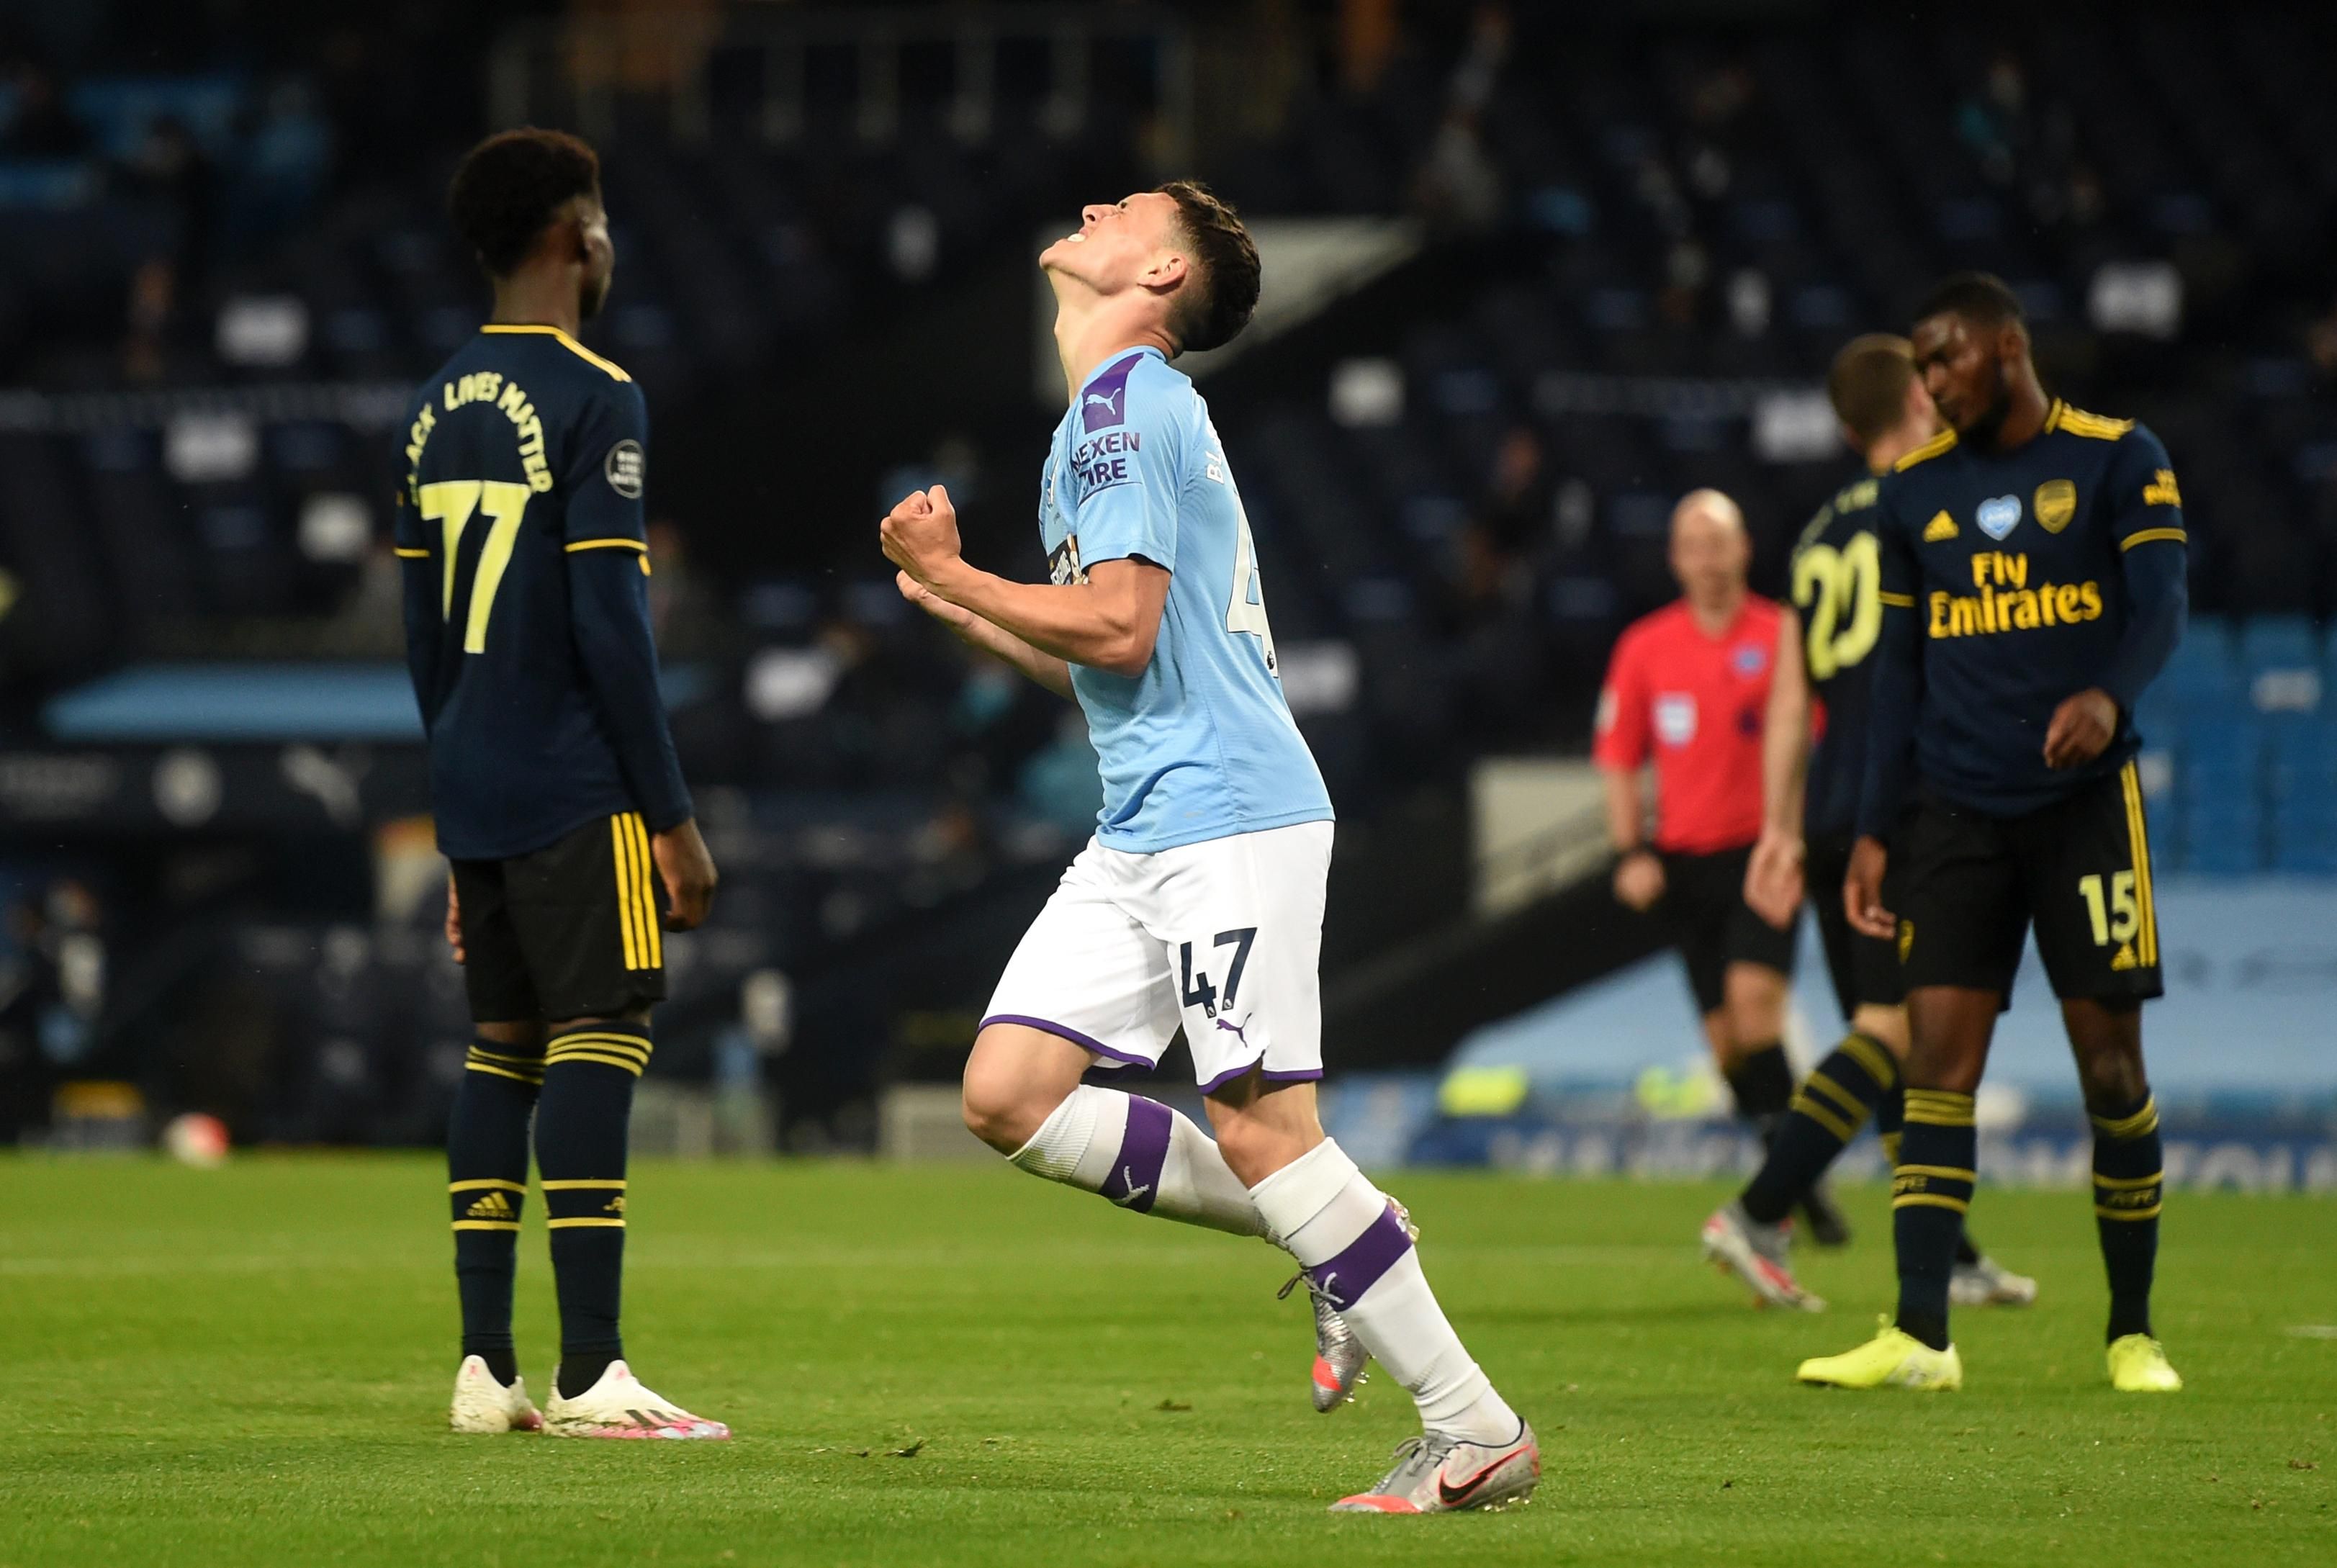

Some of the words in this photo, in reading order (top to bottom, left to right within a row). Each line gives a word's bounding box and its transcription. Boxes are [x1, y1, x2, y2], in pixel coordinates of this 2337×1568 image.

[443, 371, 503, 411] LIVES
[496, 382, 554, 494] MATTER
[1070, 431, 1141, 473] NEXEN
[1078, 457, 1128, 487] TIRE
[419, 479, 531, 654] 77
[1791, 529, 1884, 680] 20
[1971, 550, 2028, 590] Fly
[1928, 579, 2104, 639] Emirates
[2077, 869, 2140, 947] 15
[1179, 927, 1258, 1019] 47
